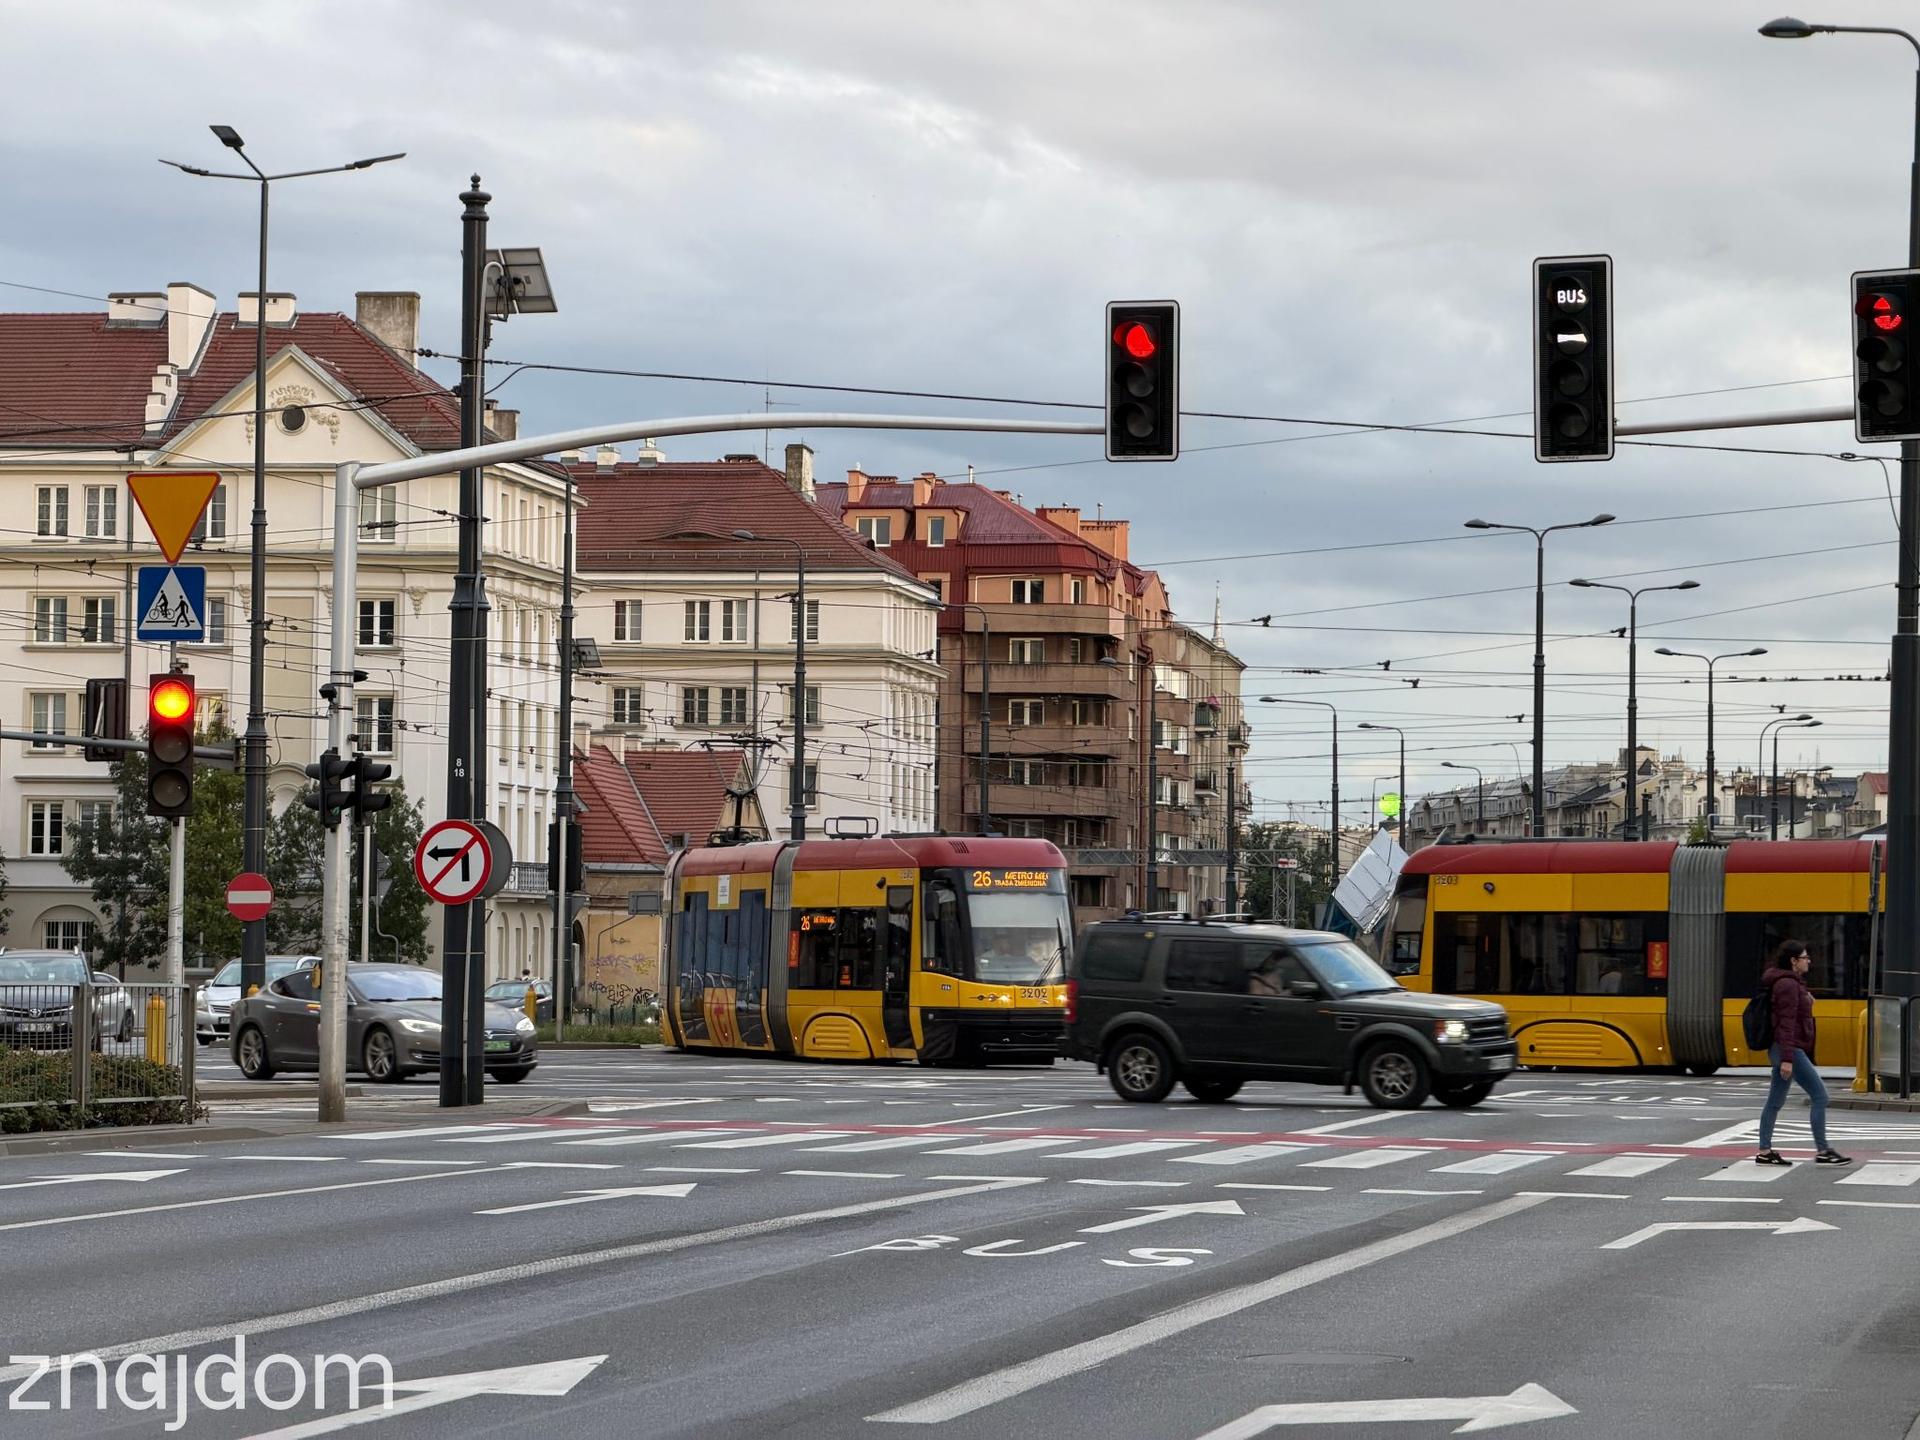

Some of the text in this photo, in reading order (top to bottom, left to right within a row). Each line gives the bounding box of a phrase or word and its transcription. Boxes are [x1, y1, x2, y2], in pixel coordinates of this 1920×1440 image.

[1557, 289, 1587, 304] BUS
[456, 757, 462, 767] 8
[454, 768, 465, 777] 18
[973, 870, 992, 887] 26
[1005, 871, 1033, 880] METRO
[1020, 987, 1048, 999] 3202
[829, 1234, 1214, 1267] BUS
